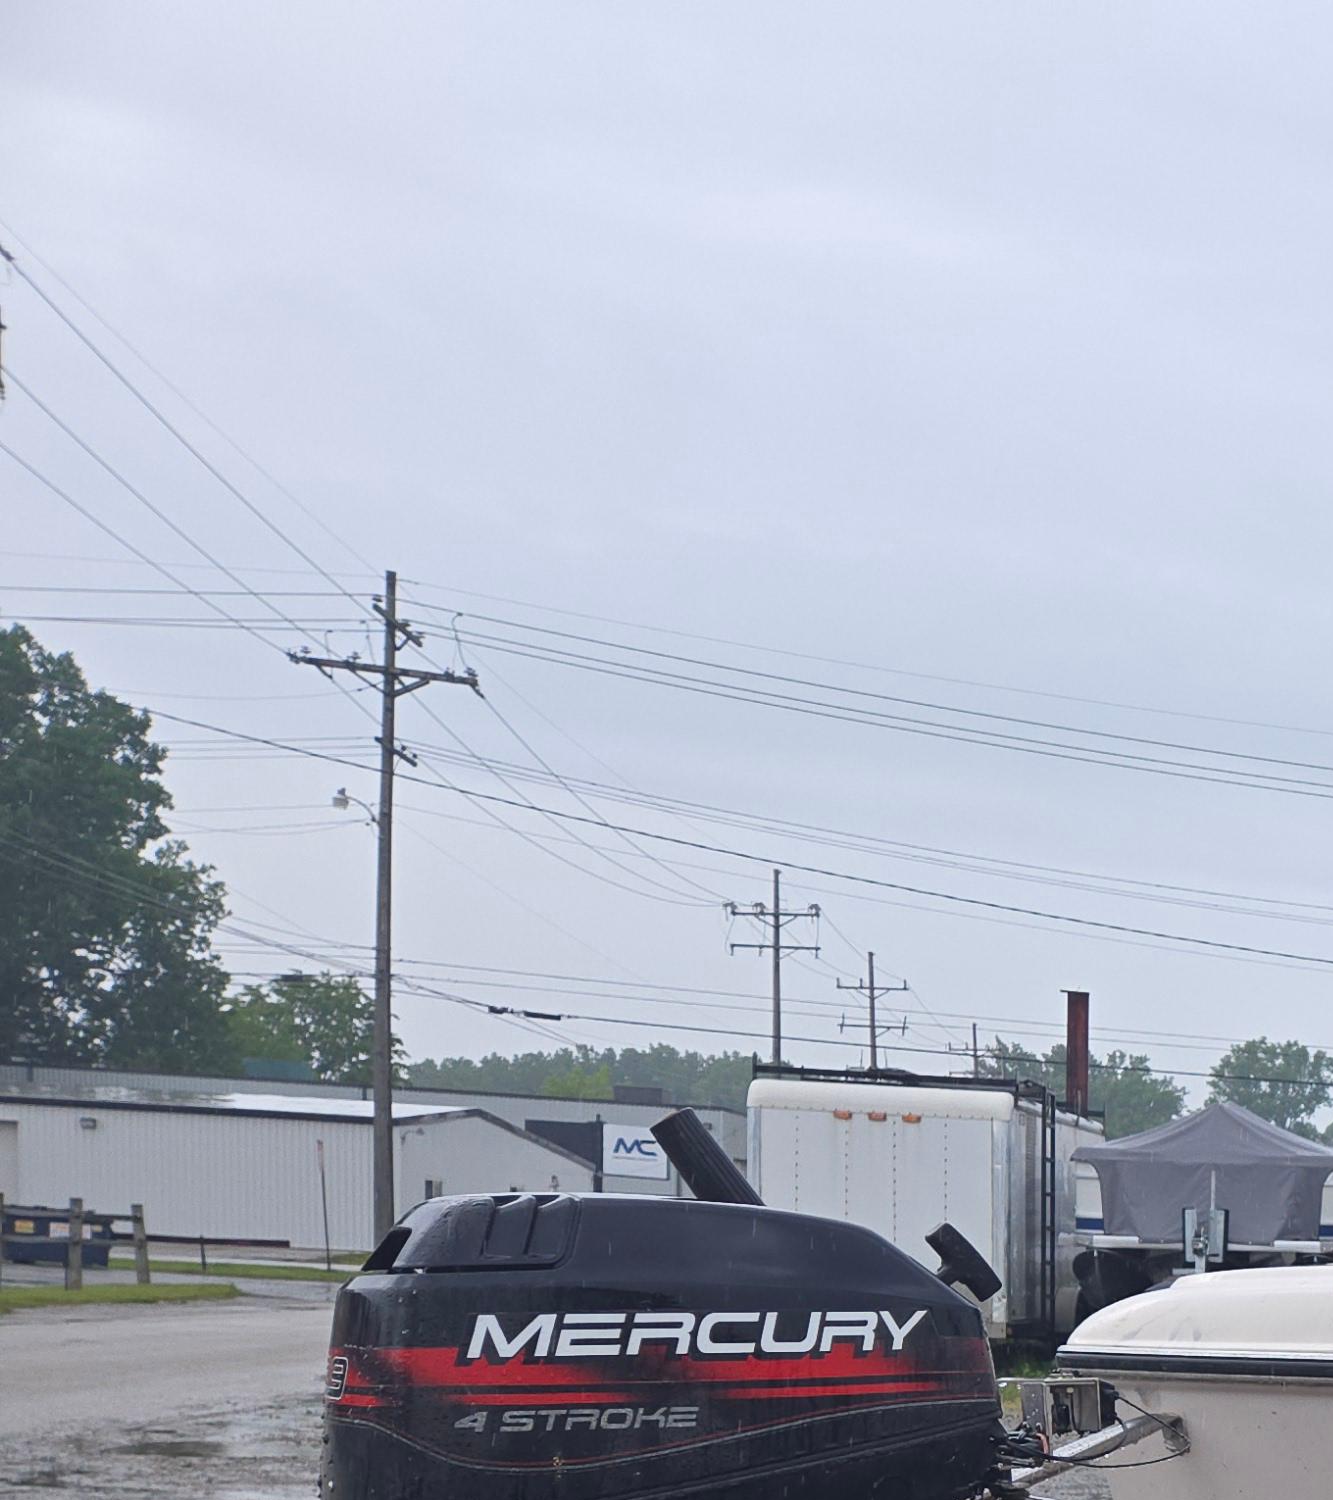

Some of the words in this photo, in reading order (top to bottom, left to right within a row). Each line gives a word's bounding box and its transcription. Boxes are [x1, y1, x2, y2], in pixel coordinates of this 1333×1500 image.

[613, 1137, 658, 1156] MC
[466, 1310, 928, 1359] MERCURY
[454, 1411, 488, 1432] 4
[500, 1406, 700, 1432] STROKE
